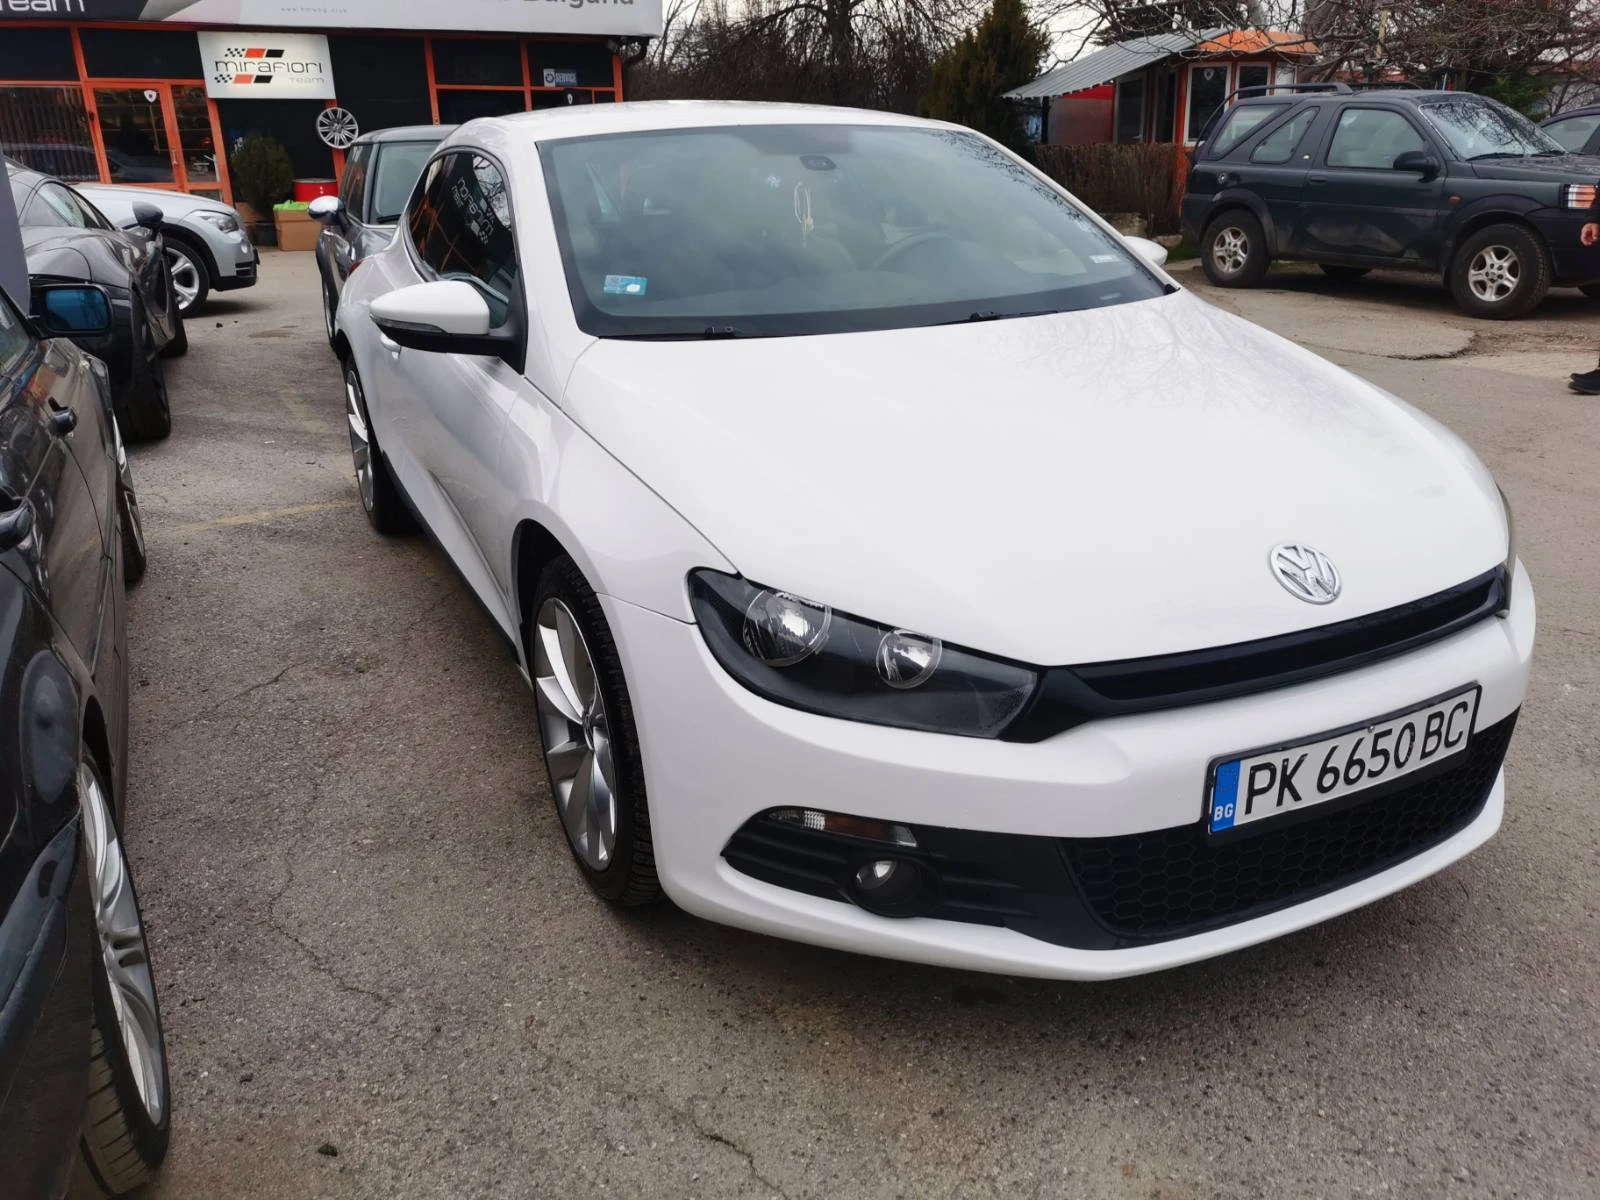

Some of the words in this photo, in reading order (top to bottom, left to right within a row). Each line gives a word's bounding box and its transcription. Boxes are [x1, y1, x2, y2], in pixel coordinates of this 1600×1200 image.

[215, 60, 323, 74] mirafiori
[1244, 753, 1308, 815] PK
[1316, 721, 1416, 794] 6650
[1419, 700, 1469, 761] BC
[1213, 803, 1234, 822] BG
